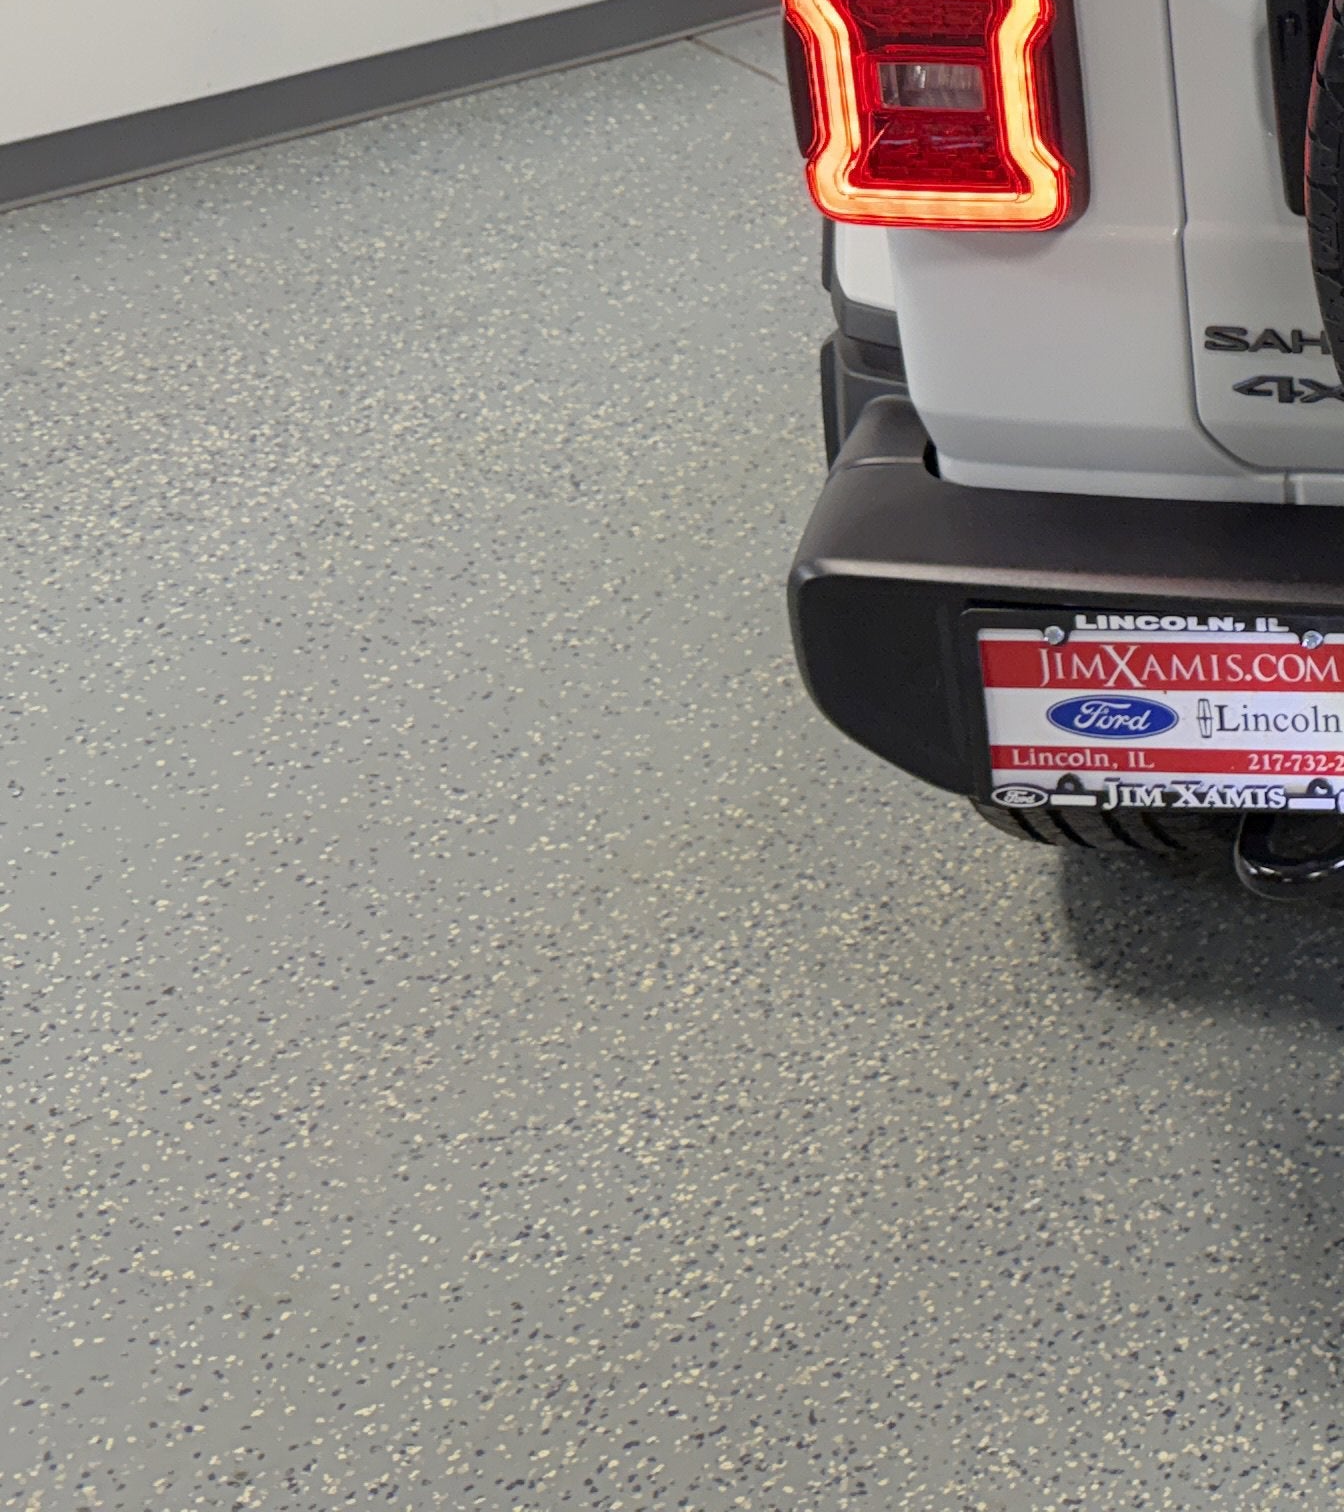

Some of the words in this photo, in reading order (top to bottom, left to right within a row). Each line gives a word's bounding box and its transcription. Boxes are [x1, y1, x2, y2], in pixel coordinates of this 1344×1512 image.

[1204, 325, 1333, 355] SAH
[1074, 614, 1245, 632] LINCOLN,
[1255, 617, 1290, 633] IL
[1039, 644, 1341, 688] JIMXAMIS.COM
[1073, 700, 1151, 731] Ford
[1214, 703, 1343, 733] Lincoln
[1011, 748, 1119, 769] Lincoln,
[1127, 751, 1155, 768] IL
[1103, 777, 1167, 810] JIM
[1171, 781, 1287, 810] XAMIS
